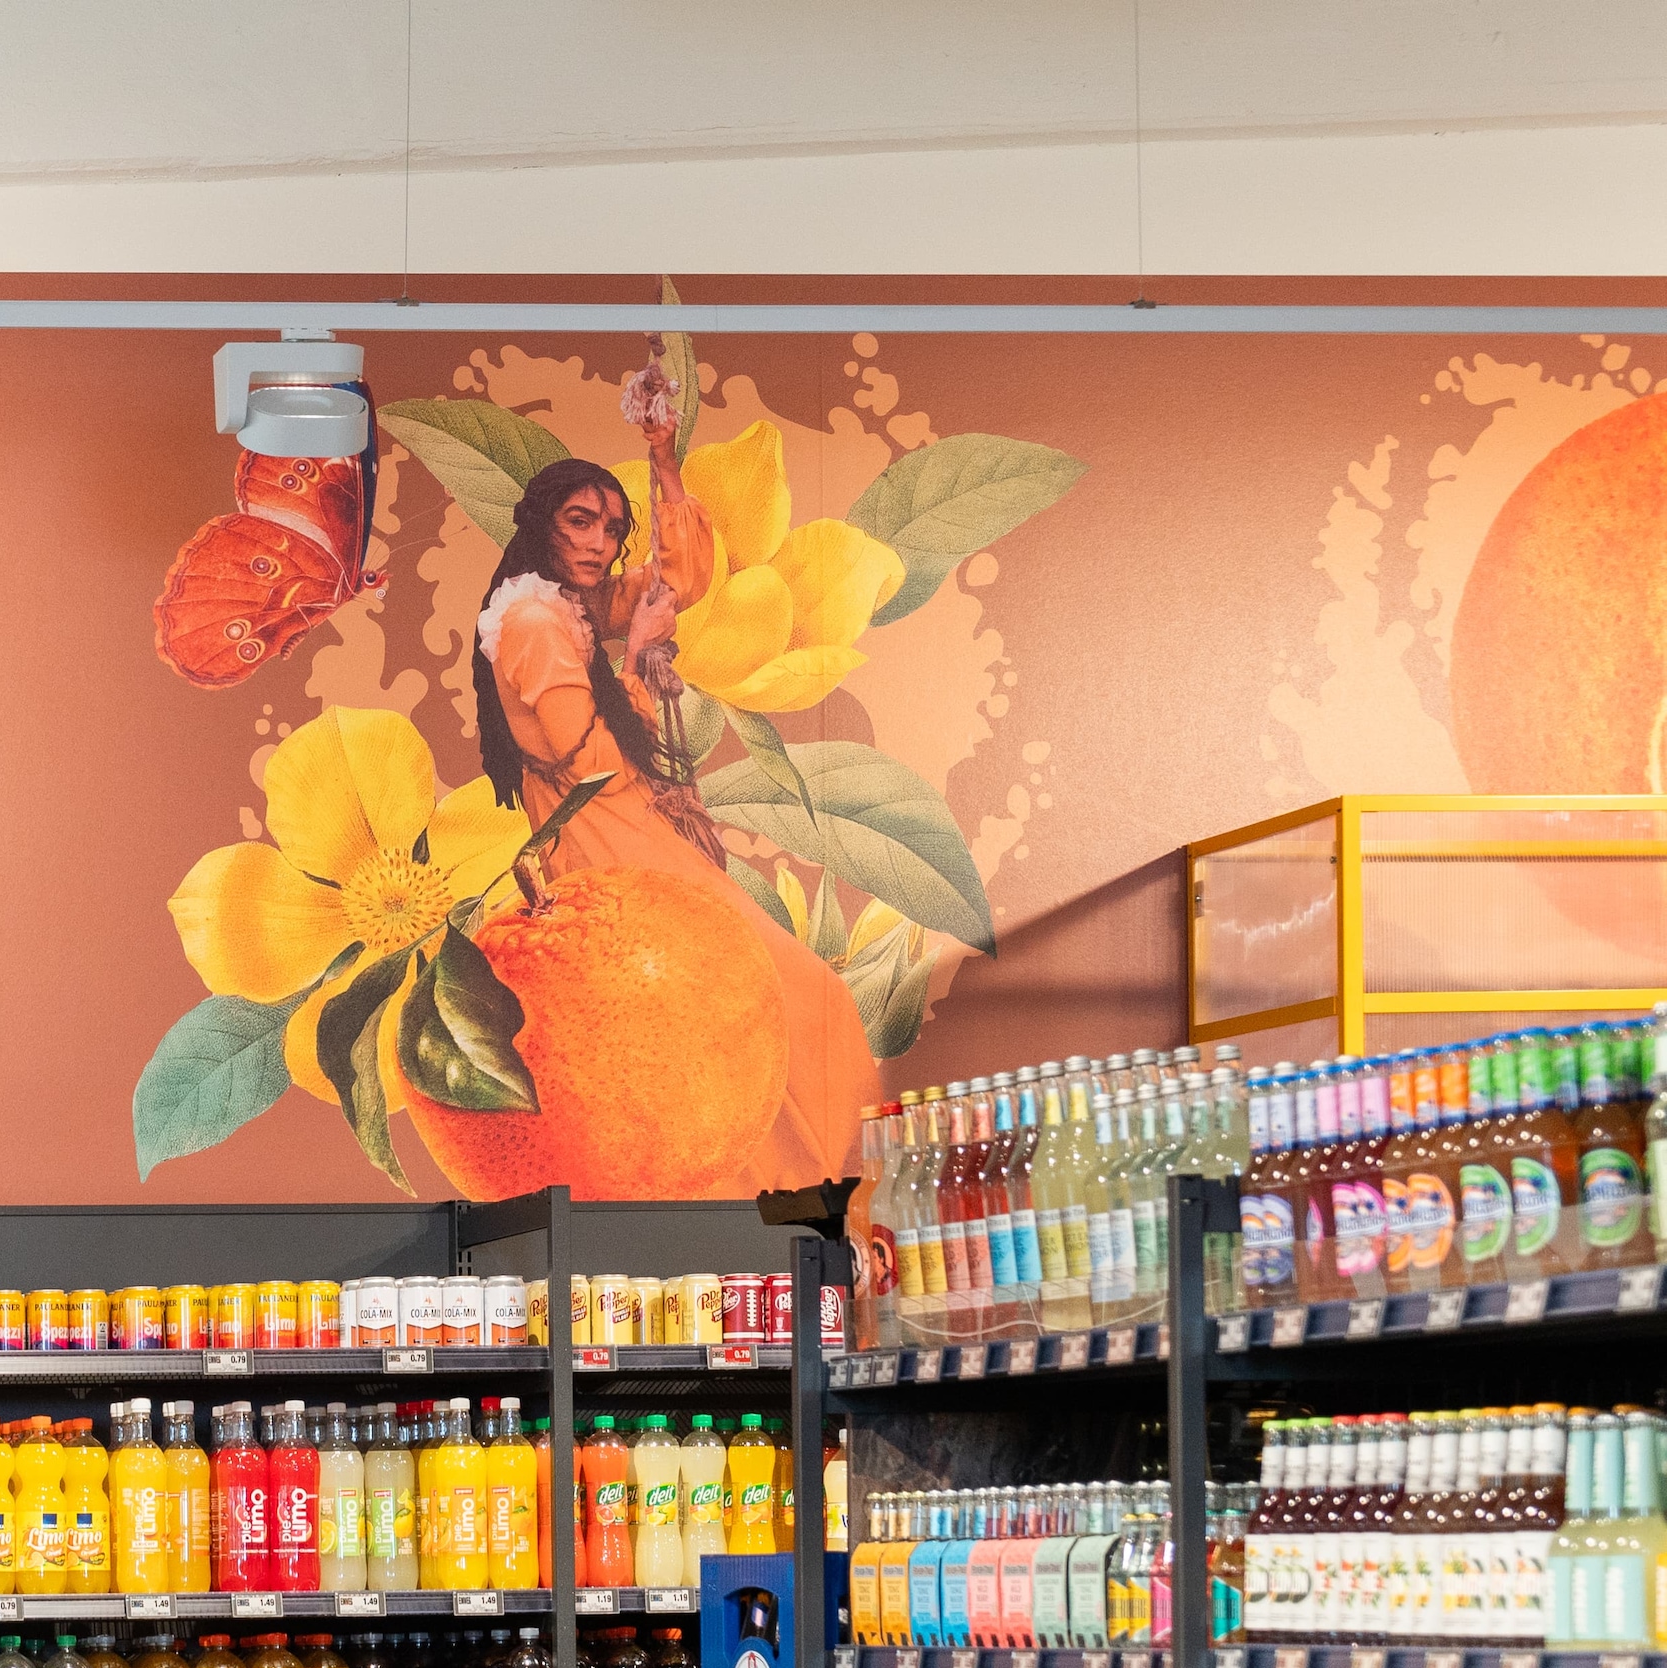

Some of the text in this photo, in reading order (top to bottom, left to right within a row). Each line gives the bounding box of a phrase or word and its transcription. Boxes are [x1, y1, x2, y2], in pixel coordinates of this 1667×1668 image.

[410, 1354, 426, 1363] 0.79
[592, 1351, 609, 1360] 0.79
[734, 1351, 750, 1359] 0.79
[230, 1356, 246, 1364] 0.79
[599, 1483, 625, 1505] deit
[649, 1484, 676, 1504] deit
[695, 1483, 722, 1504] deit
[745, 1483, 772, 1504] deit
[27, 1528, 65, 1551] Limo
[67, 1528, 103, 1550] Limo
[363, 1597, 378, 1606] 1.49
[481, 1596, 496, 1605] 1.49
[596, 1594, 612, 1603] 1.19
[673, 1593, 688, 1602] 1.19
[0, 1601, 16, 1610] 0.79
[154, 1600, 169, 1608] 1.49
[260, 1598, 275, 1607] 1.49
